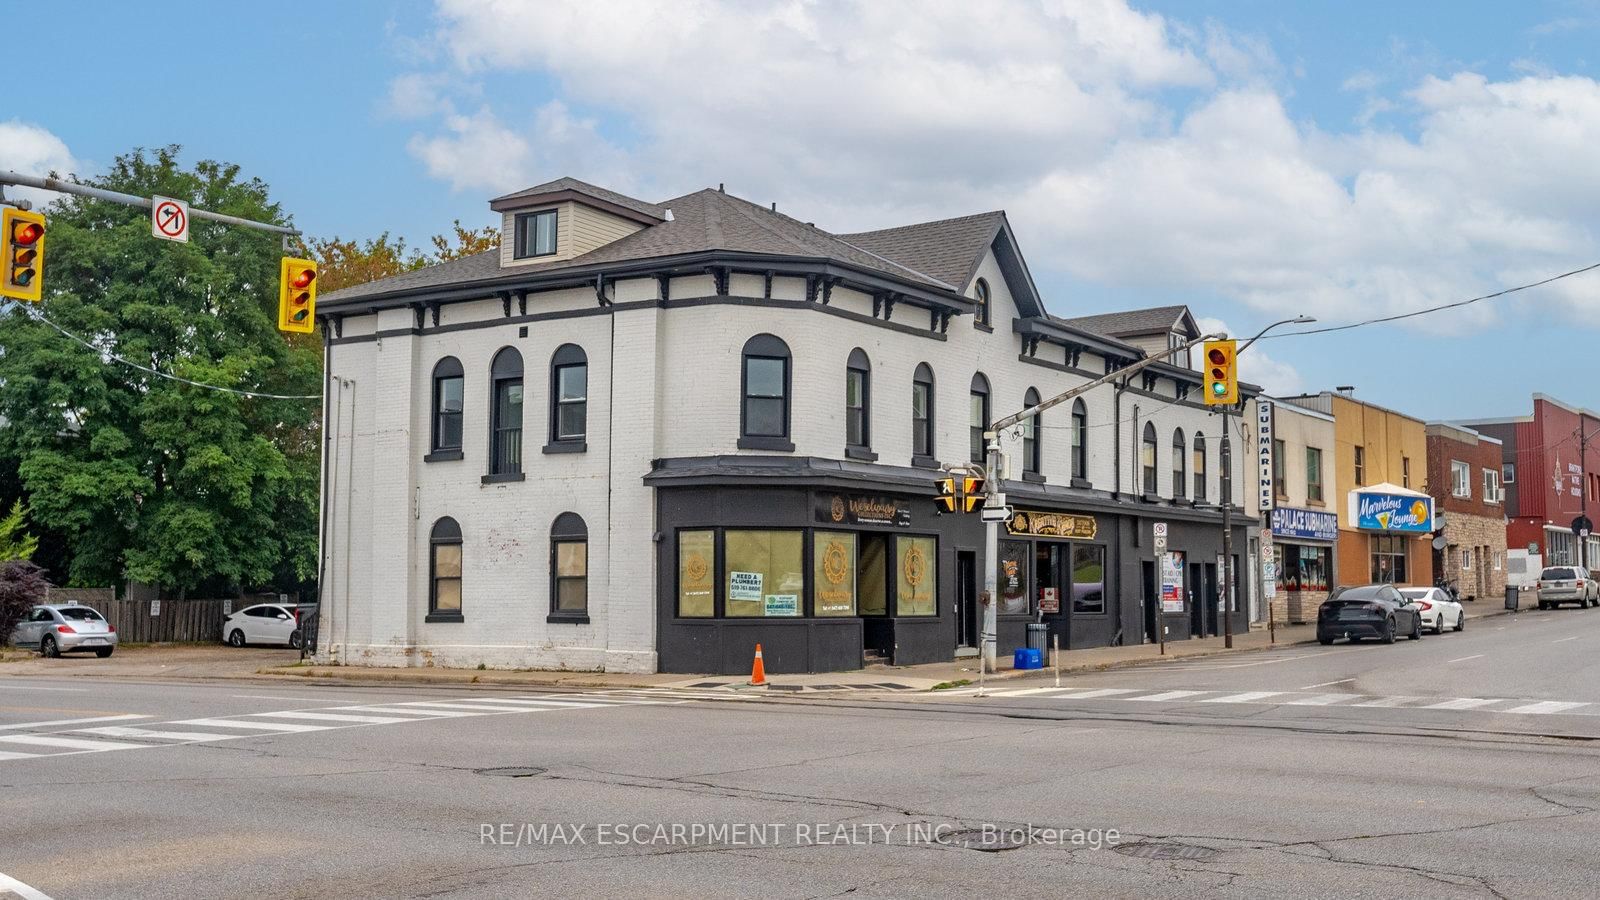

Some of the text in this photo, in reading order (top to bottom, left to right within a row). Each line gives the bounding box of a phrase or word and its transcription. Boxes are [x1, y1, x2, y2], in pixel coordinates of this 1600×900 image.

[1260, 405, 1271, 507] SUBMARINES
[1359, 495, 1402, 519] Marvelous
[1388, 509, 1418, 528] Lounge
[1280, 509, 1337, 533] PALACE SUBMARINE
